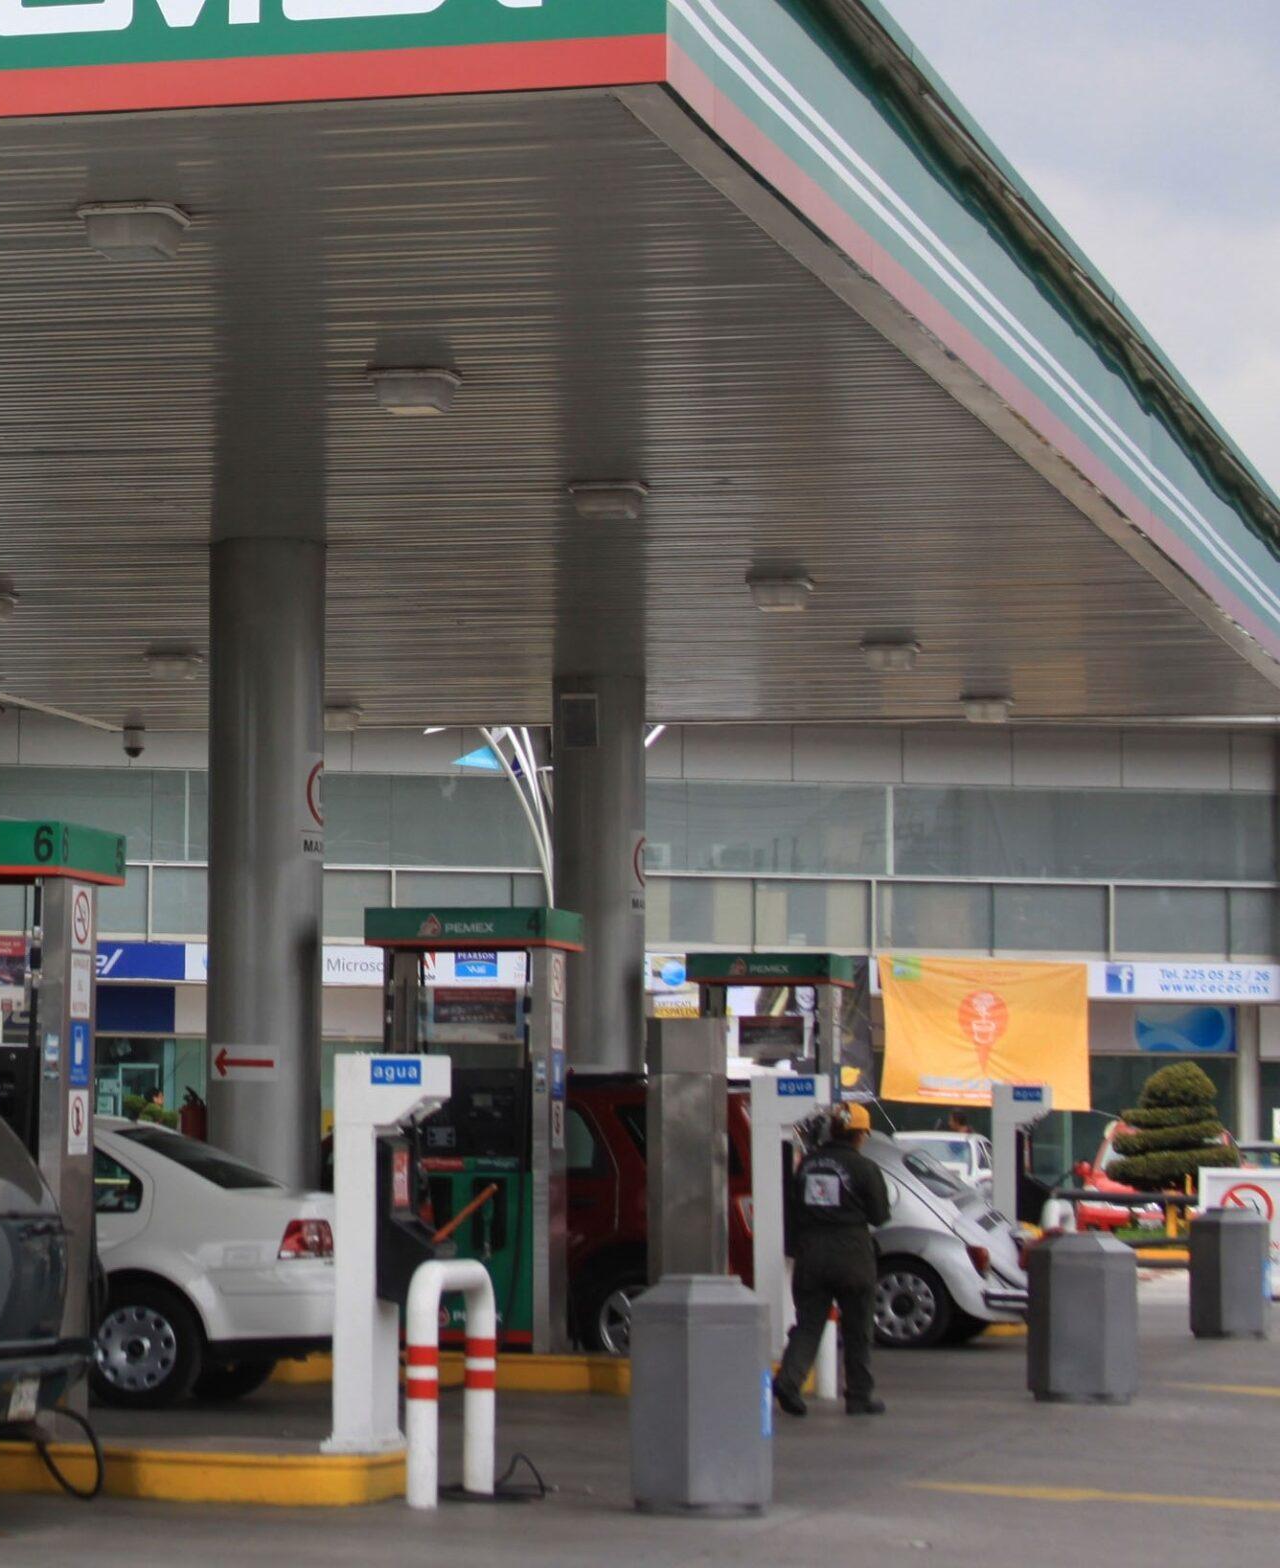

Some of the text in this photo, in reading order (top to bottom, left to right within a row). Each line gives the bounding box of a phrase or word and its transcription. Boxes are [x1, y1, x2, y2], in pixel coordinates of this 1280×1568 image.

[33, 825, 54, 862] 6
[445, 923, 494, 933] PEMEX
[457, 952, 495, 960] PEARSON
[326, 958, 384, 973] Microso
[1160, 968, 1179, 980] Tel.
[1183, 969, 1206, 980] 225
[1208, 969, 1225, 981] 05
[1228, 970, 1243, 981] 25
[373, 1066, 417, 1081] agua
